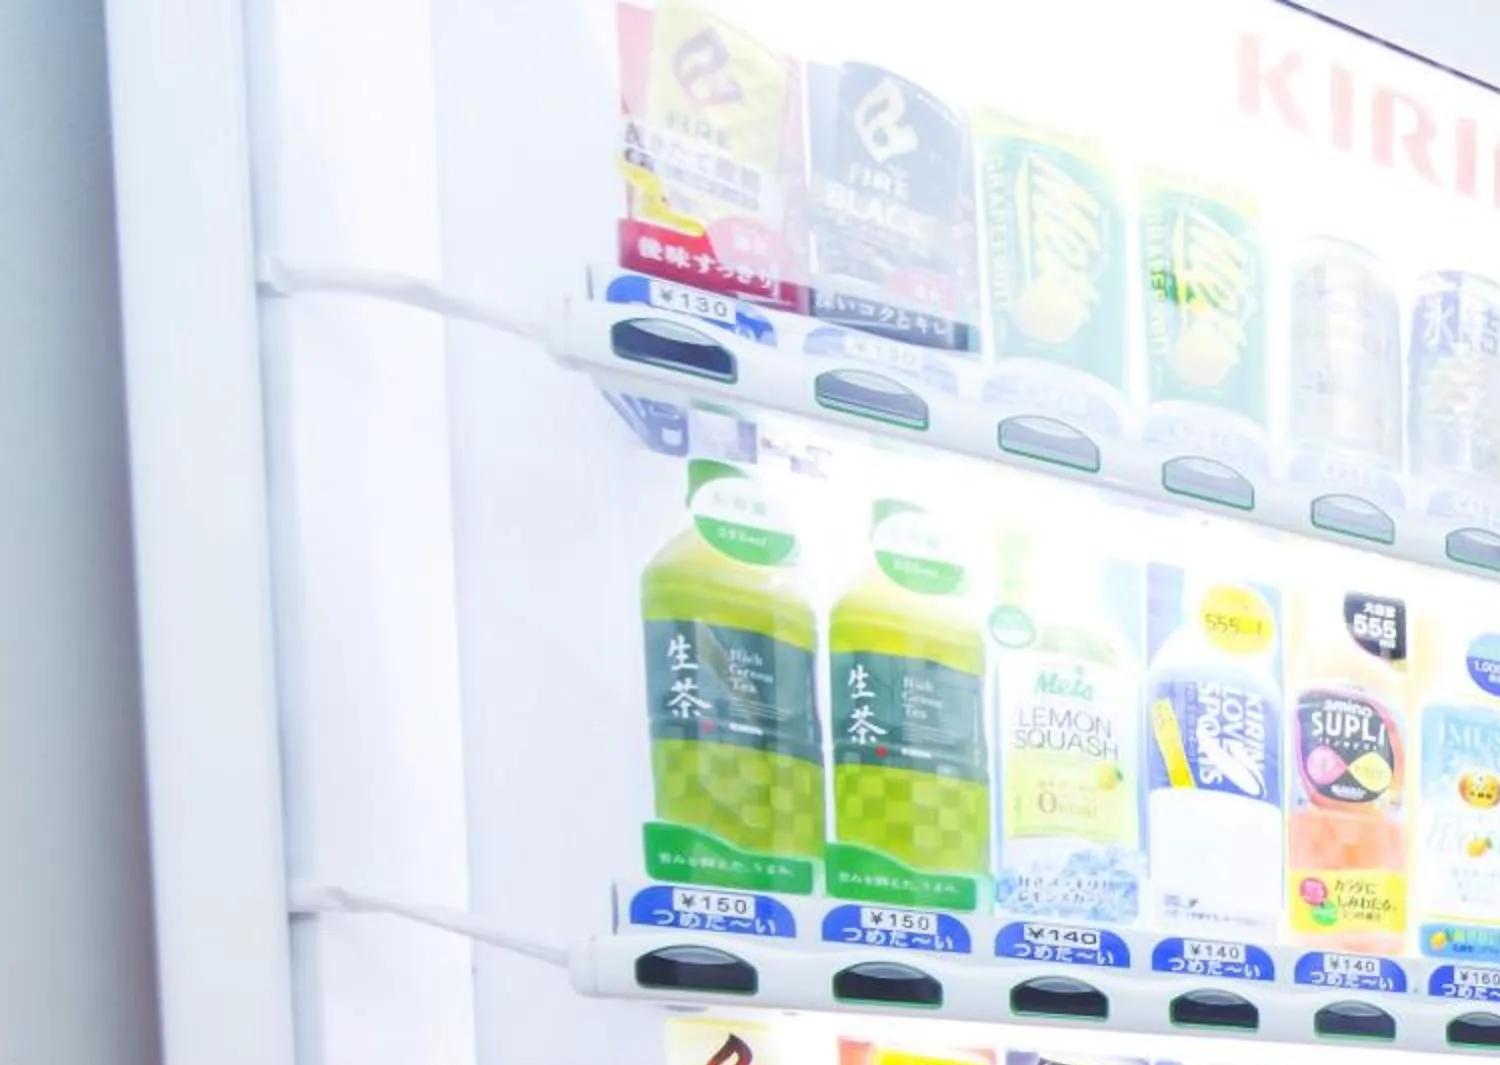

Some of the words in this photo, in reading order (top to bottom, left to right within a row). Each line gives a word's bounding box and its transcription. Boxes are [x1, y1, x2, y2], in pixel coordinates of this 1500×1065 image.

[657, 287, 729, 317] ¥130
[1353, 614, 1398, 639] 555
[667, 634, 712, 719] 生茶
[729, 678, 758, 695] Tea
[848, 664, 887, 744] 生茶
[1323, 698, 1374, 718] amino
[1018, 705, 1113, 740] LEMON
[1311, 711, 1386, 747] SUPLI
[1014, 728, 1120, 762] SQUASH
[680, 892, 748, 915] ¥150
[868, 910, 931, 931] ¥150
[1028, 926, 1098, 946] ¥140
[1189, 943, 1241, 960] ¥140
[1329, 955, 1376, 974] ¥140
